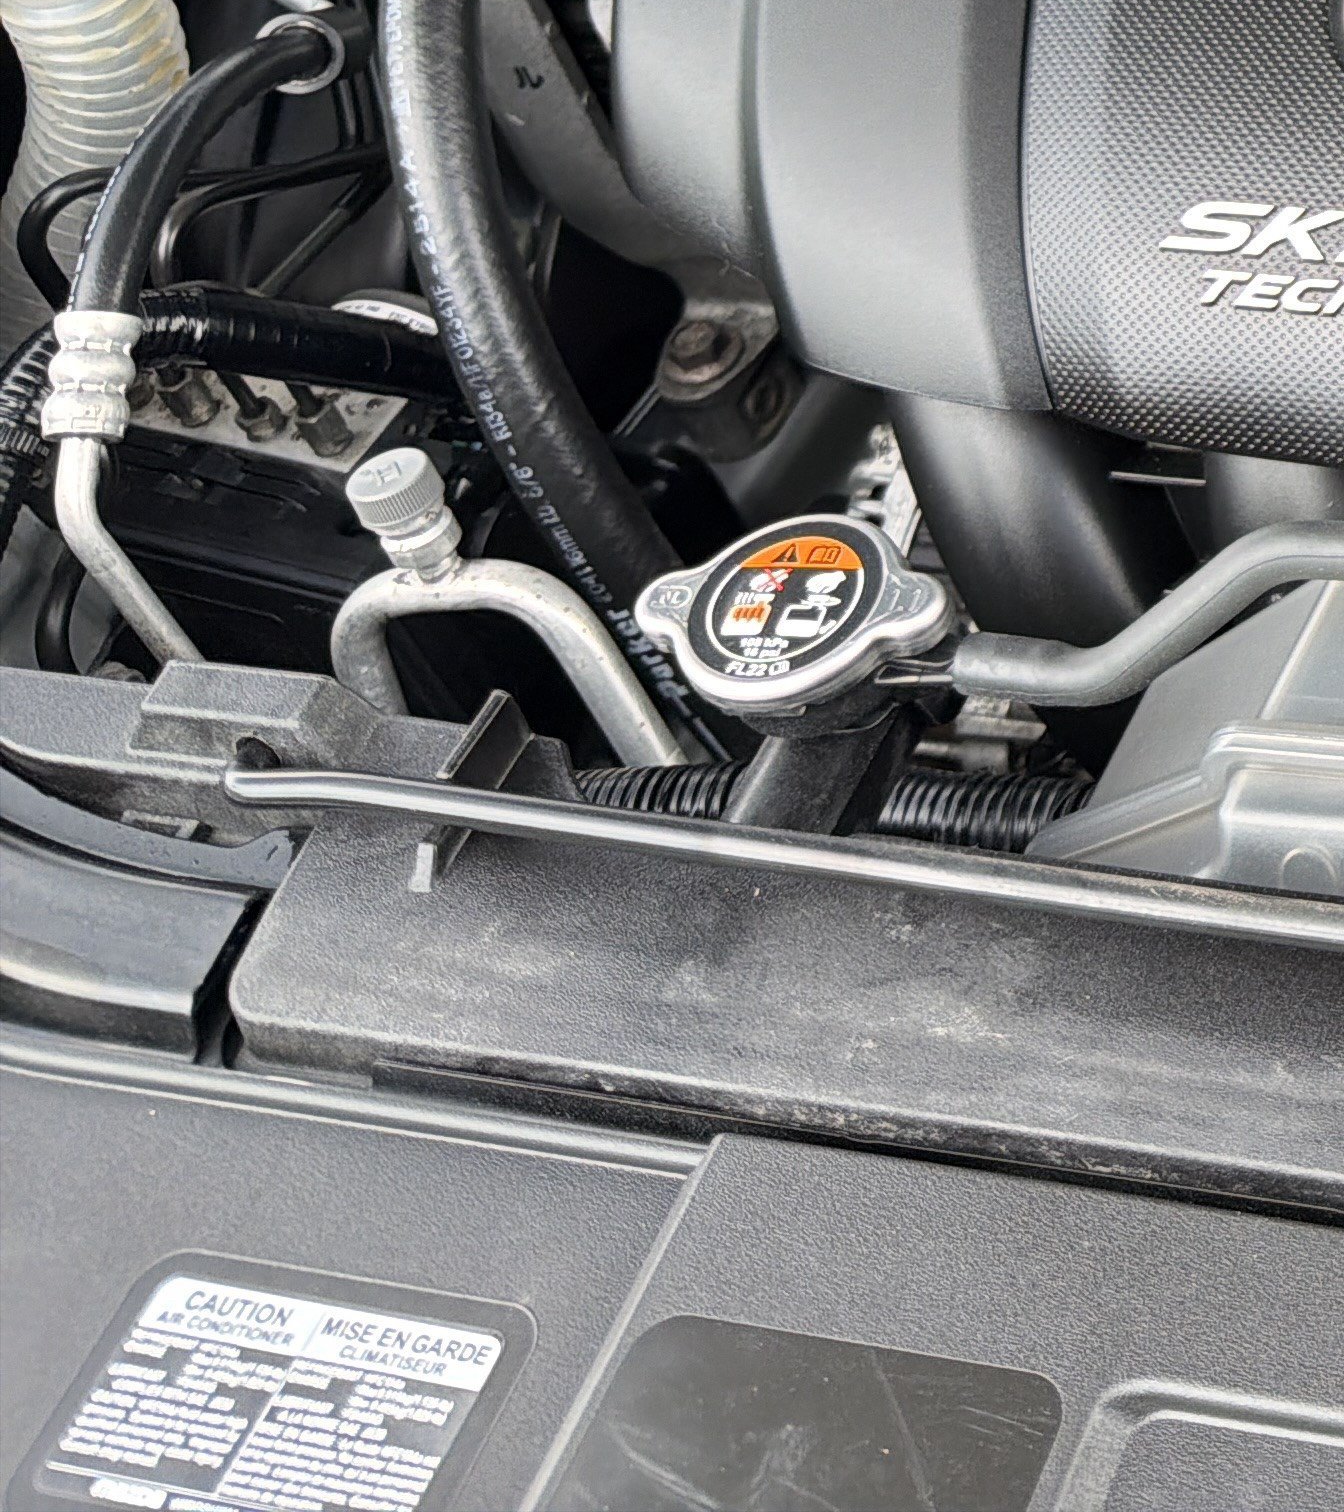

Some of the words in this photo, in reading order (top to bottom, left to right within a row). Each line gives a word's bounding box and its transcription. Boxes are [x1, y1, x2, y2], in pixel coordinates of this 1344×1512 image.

[725, 661, 767, 676] FL22
[185, 1289, 295, 1327] CAUTION
[156, 1310, 184, 1325] AIR
[187, 1314, 295, 1347] CONDITIONER
[321, 1317, 377, 1344] MISE
[378, 1327, 411, 1350] EN
[411, 1333, 493, 1366] GARDE
[339, 1344, 448, 1377] CLIMATISEUR
